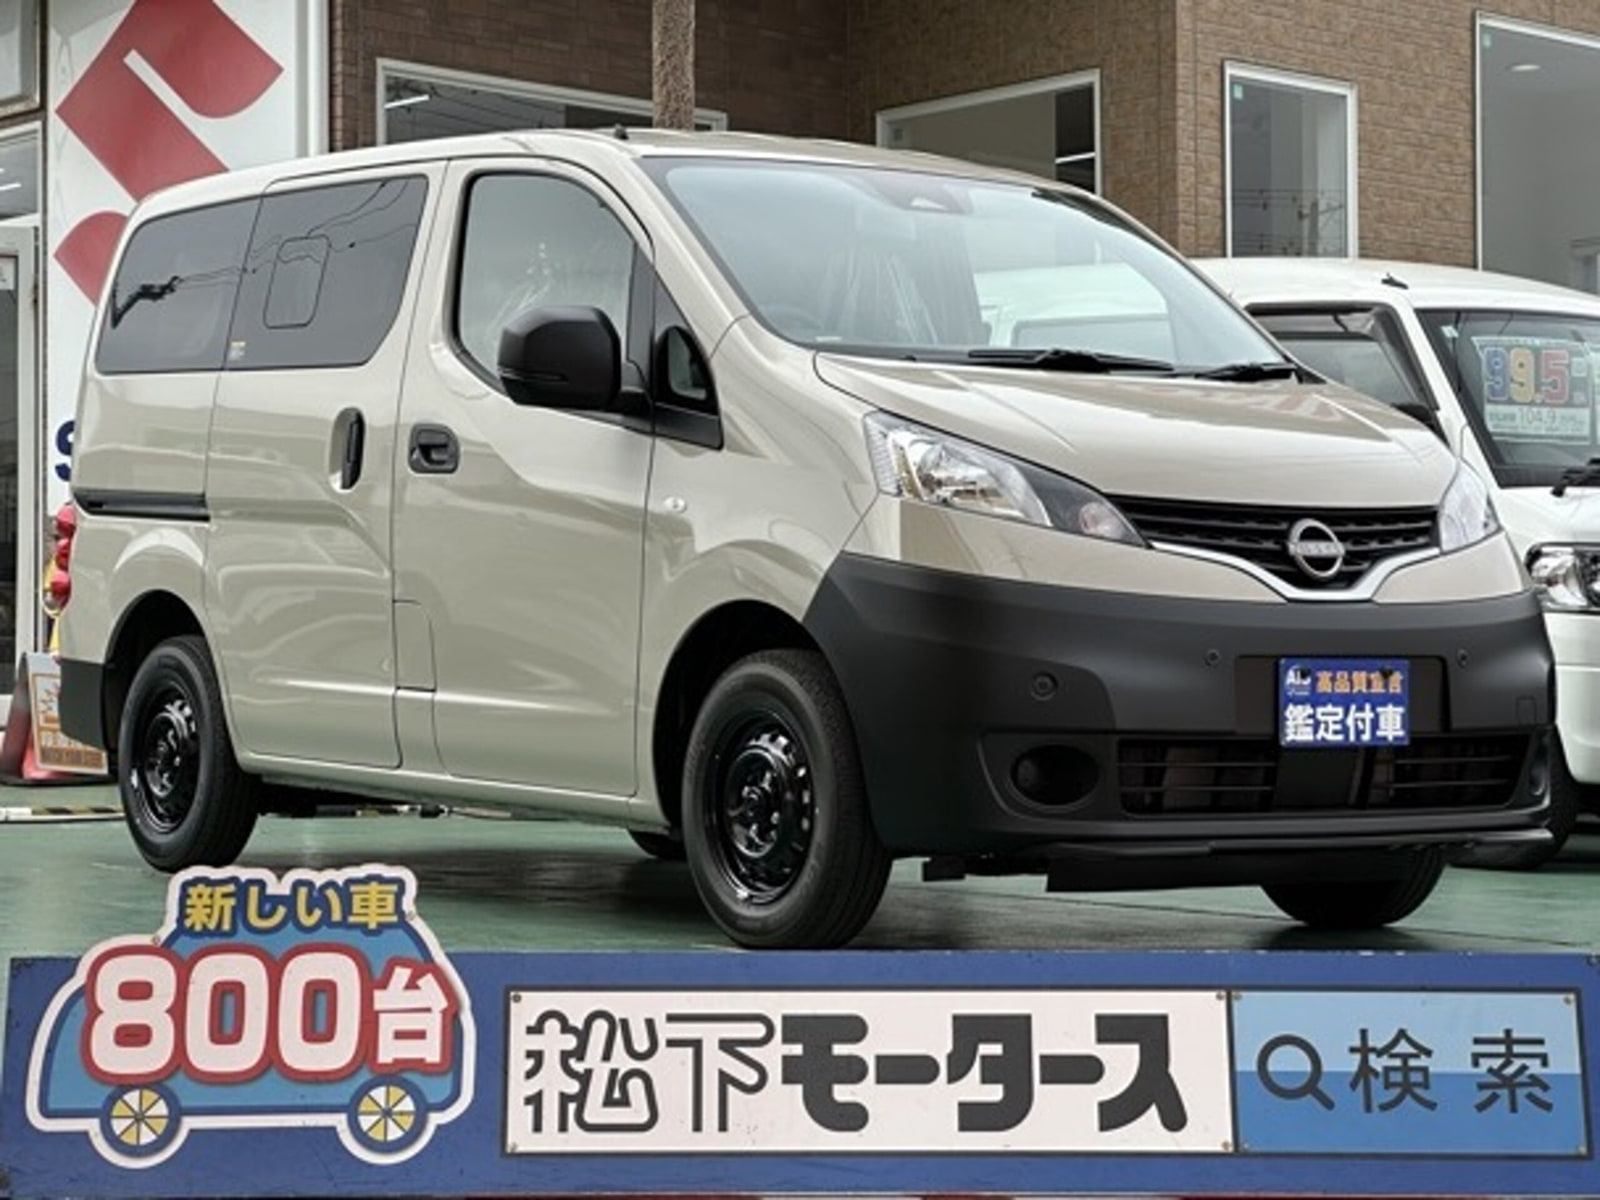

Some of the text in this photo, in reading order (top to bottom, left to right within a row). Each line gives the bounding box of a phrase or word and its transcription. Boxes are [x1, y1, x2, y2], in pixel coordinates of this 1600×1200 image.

[1484, 346, 1569, 404] 99.5
[1284, 703, 1405, 742] 鑑定付車
[184, 881, 398, 932] 新しい車
[90, 951, 449, 1075] 800台
[524, 1008, 1189, 1133] 松下モータース
[1349, 1028, 1554, 1114] 検索
